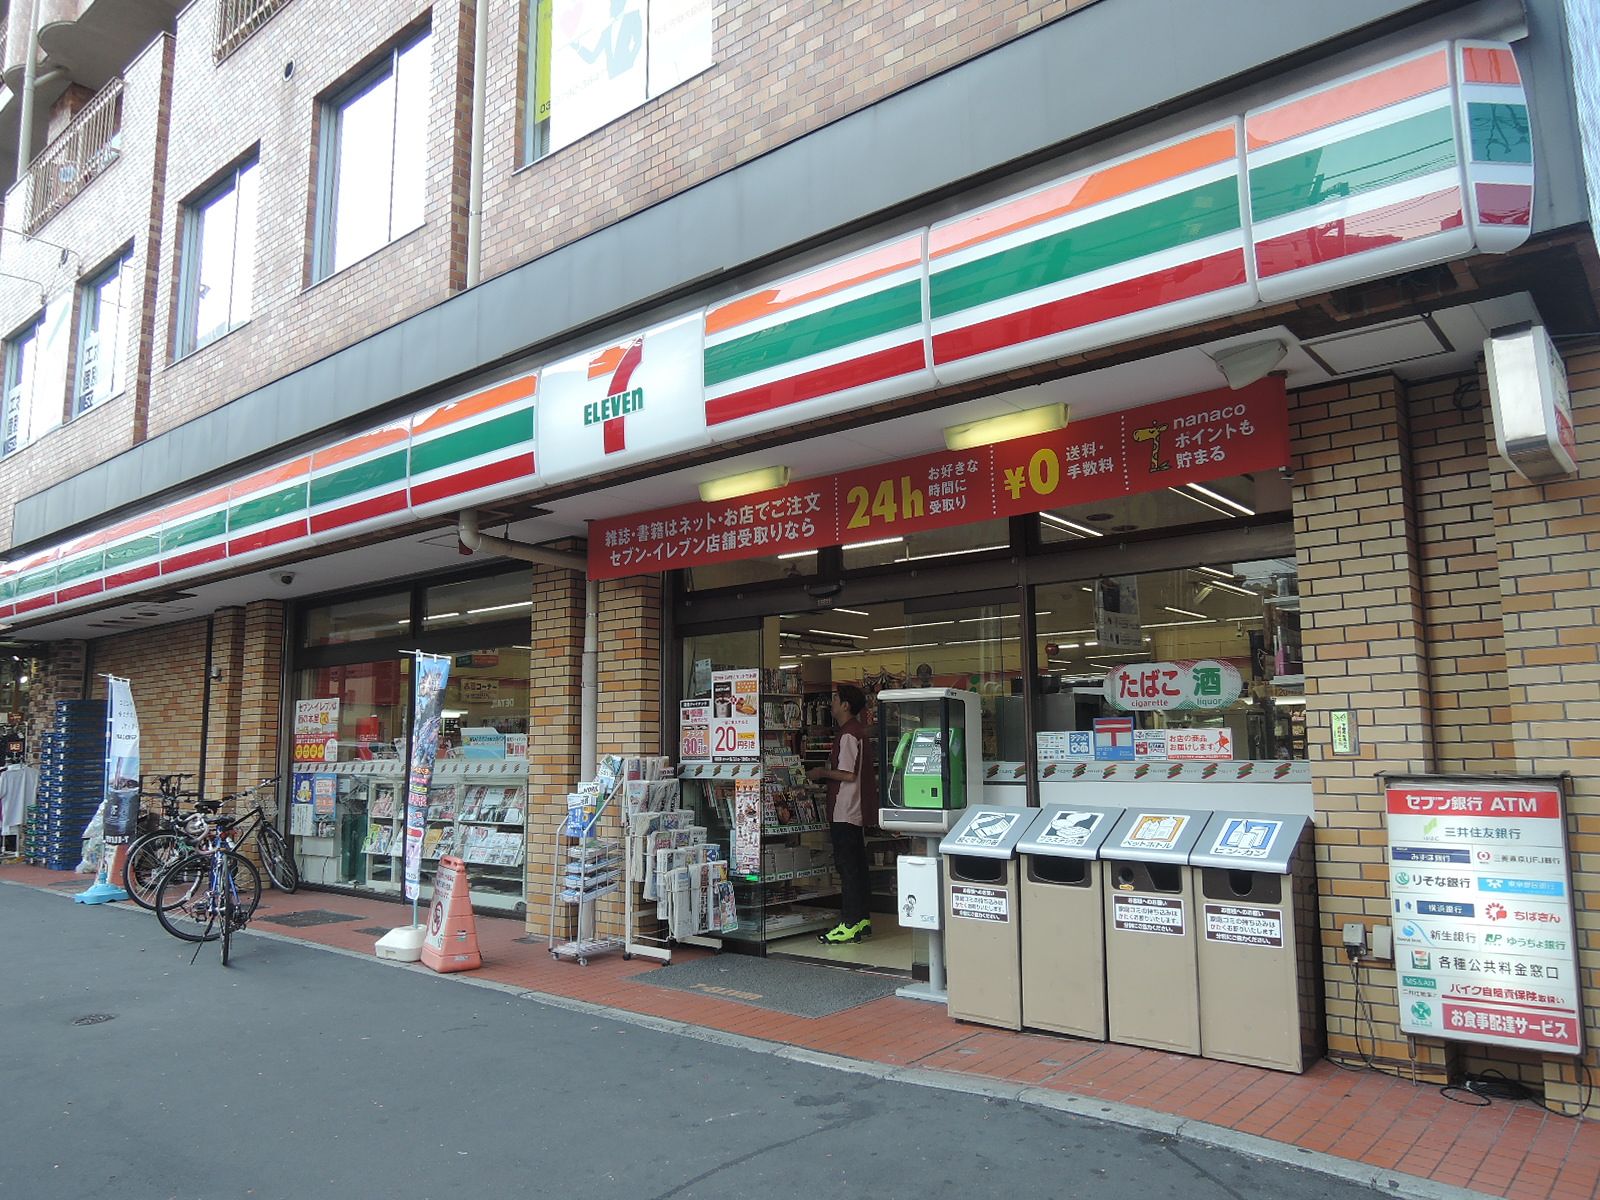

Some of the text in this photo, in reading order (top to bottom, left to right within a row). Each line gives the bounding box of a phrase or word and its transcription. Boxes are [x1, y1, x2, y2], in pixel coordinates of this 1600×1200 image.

[1173, 402, 1247, 431] nanaco
[1174, 419, 1256, 449] ポイントも
[1066, 457, 1115, 480] 手数料
[1175, 448, 1226, 470] 貯まる
[927, 458, 979, 482] お好きな
[928, 478, 968, 498] 時間に
[846, 475, 925, 530] 24h
[928, 494, 967, 516] 受取り
[604, 491, 822, 548] 雑誌・書籍はネット・お店でご注文
[1119, 668, 1181, 699] たばこ
[1192, 667, 1222, 697] 酒
[1131, 698, 1169, 707] cigarette
[1197, 697, 1222, 706] liquor
[682, 738, 698, 755] 30
[715, 726, 737, 752] 20
[737, 740, 756, 750] 円引き
[1169, 734, 1208, 743] お店の商品
[1405, 794, 1538, 813] セブン銀行 ATM
[1444, 826, 1522, 841] 三井住友銀行
[1122, 840, 1174, 850] ペットボトル
[1410, 853, 1451, 863] みずほ銀行
[1412, 874, 1471, 888] りそな銀行
[1427, 904, 1463, 914] 横浜銀行
[1429, 929, 1477, 944] 新生銀行
[1506, 936, 1567, 951] ゆうちょ銀行
[1438, 955, 1560, 980] 各種公共料金窓口
[1451, 1008, 1569, 1039] お食事配達サービス
